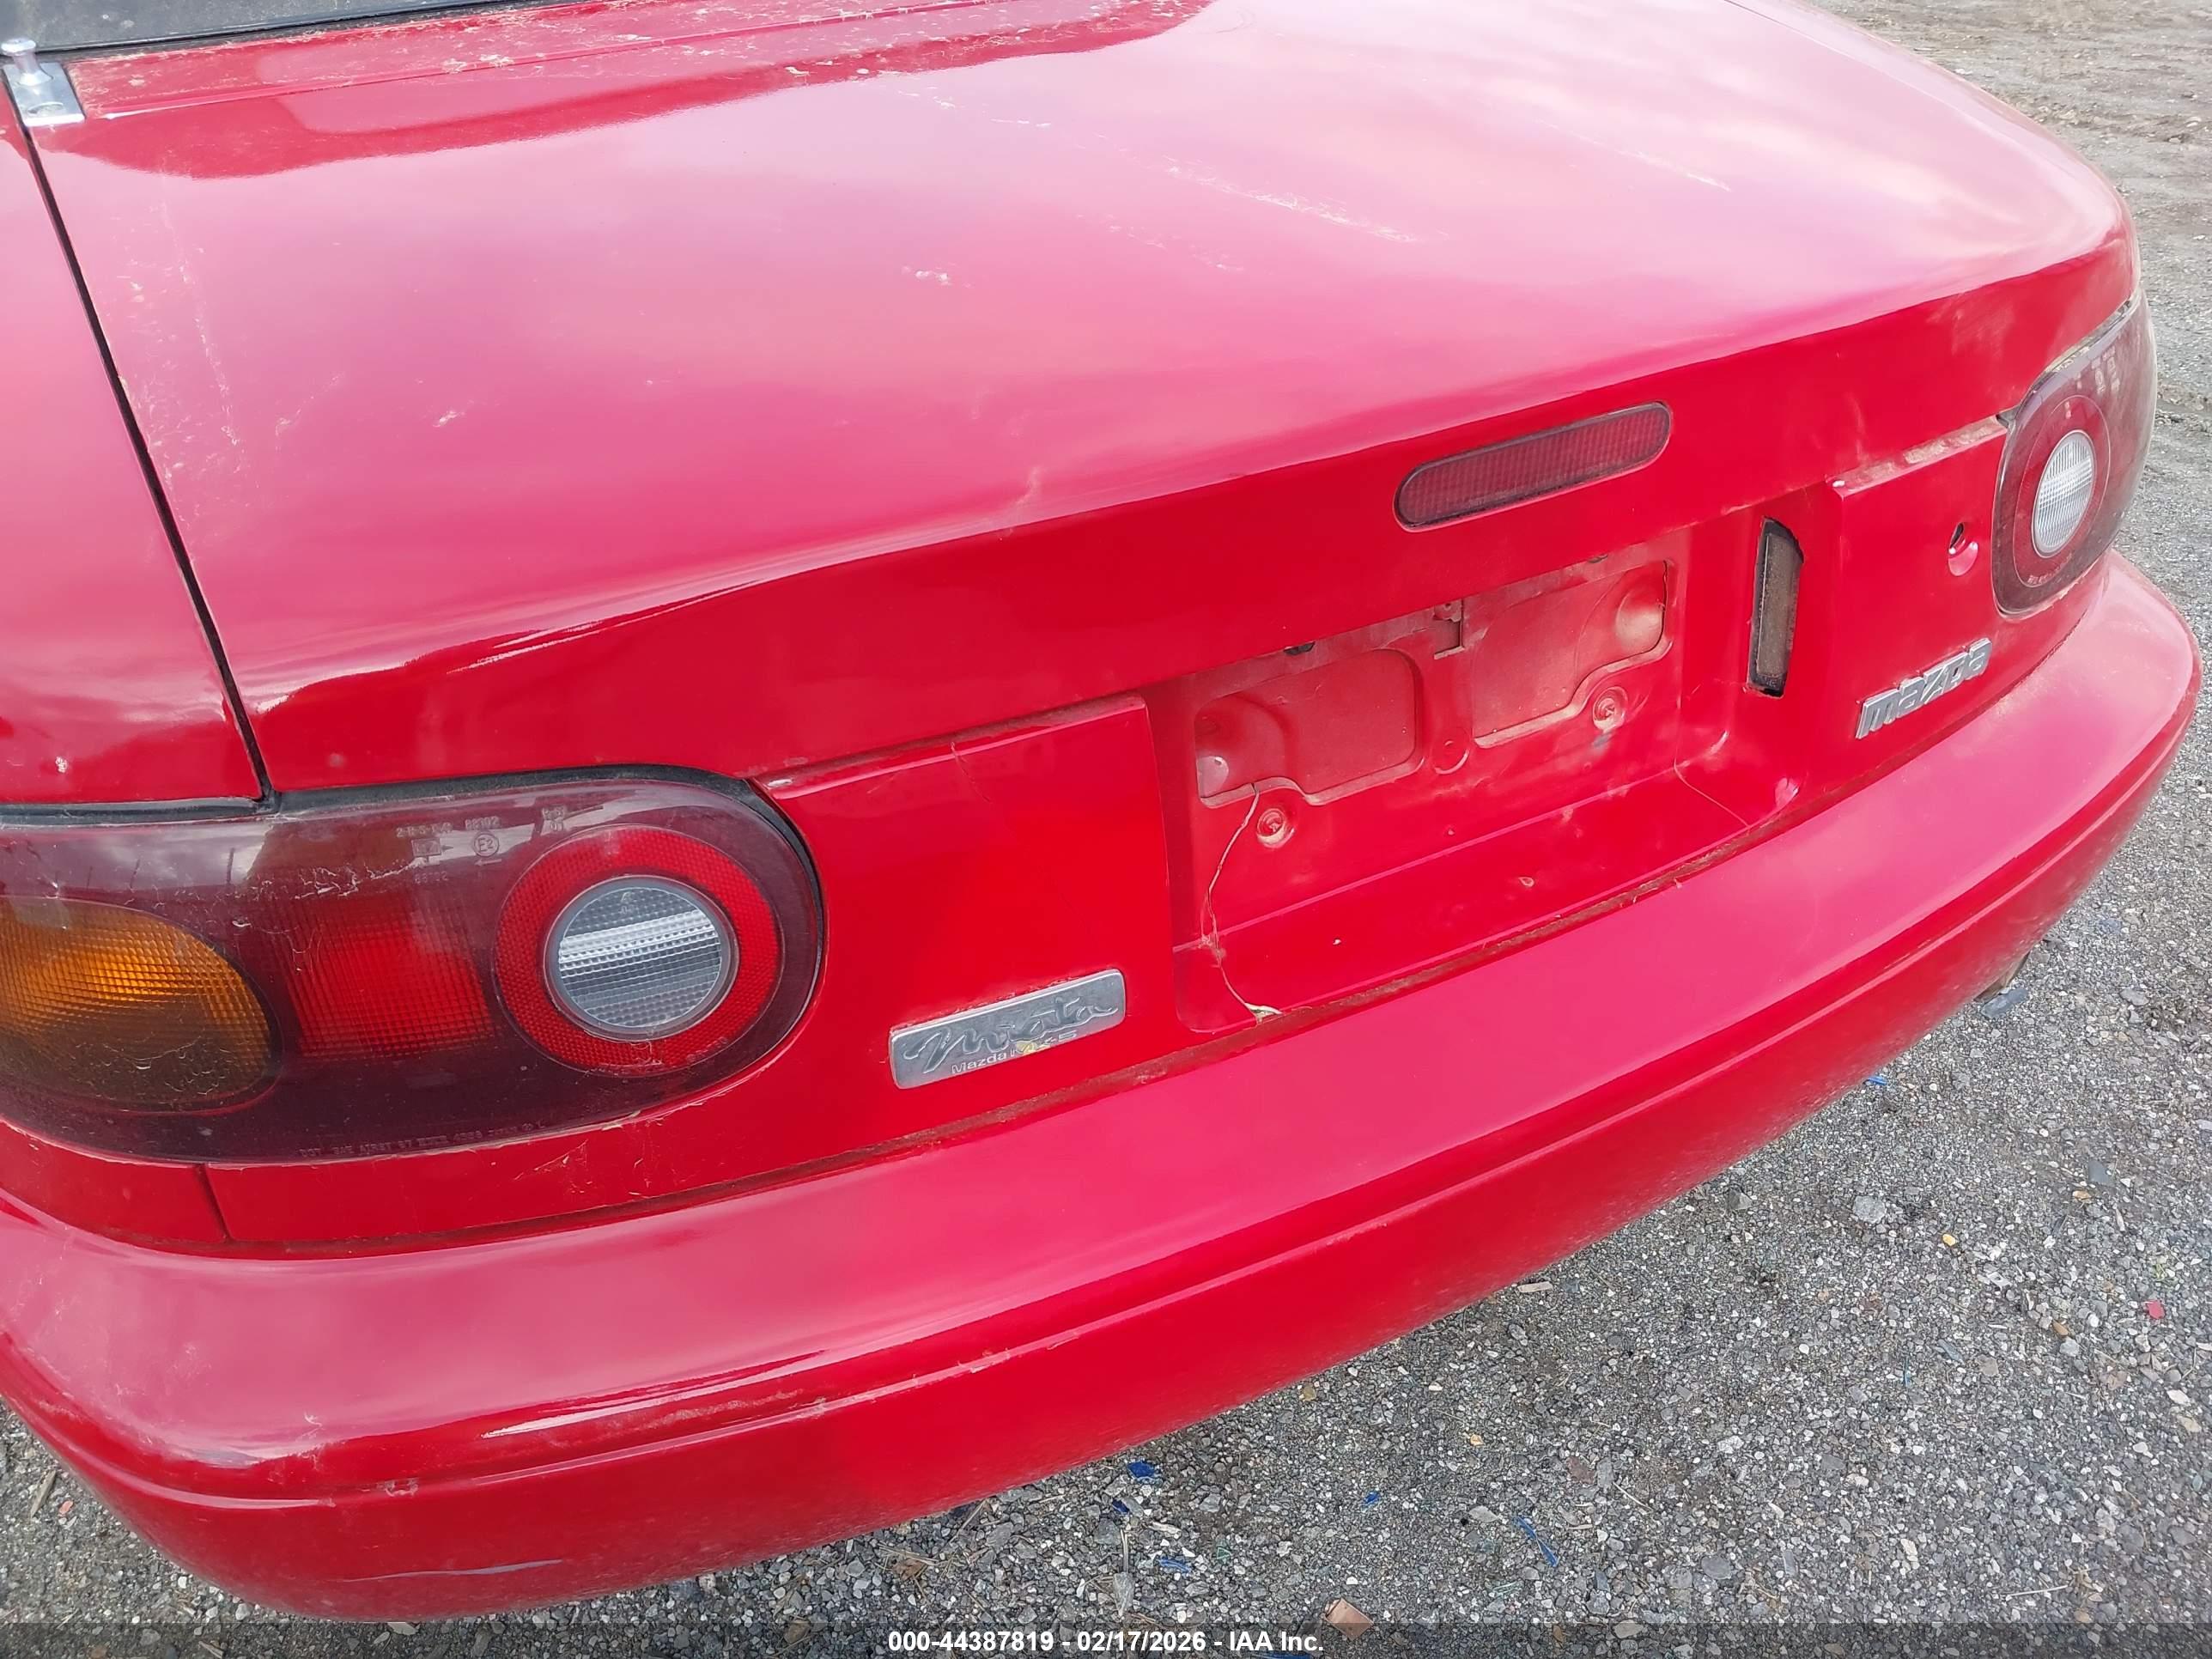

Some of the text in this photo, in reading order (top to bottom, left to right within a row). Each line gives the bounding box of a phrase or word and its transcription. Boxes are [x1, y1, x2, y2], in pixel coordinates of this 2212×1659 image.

[1855, 636, 1993, 740] mazda
[902, 996, 1119, 1074] Miata
[951, 1052, 1007, 1074] Mazda
